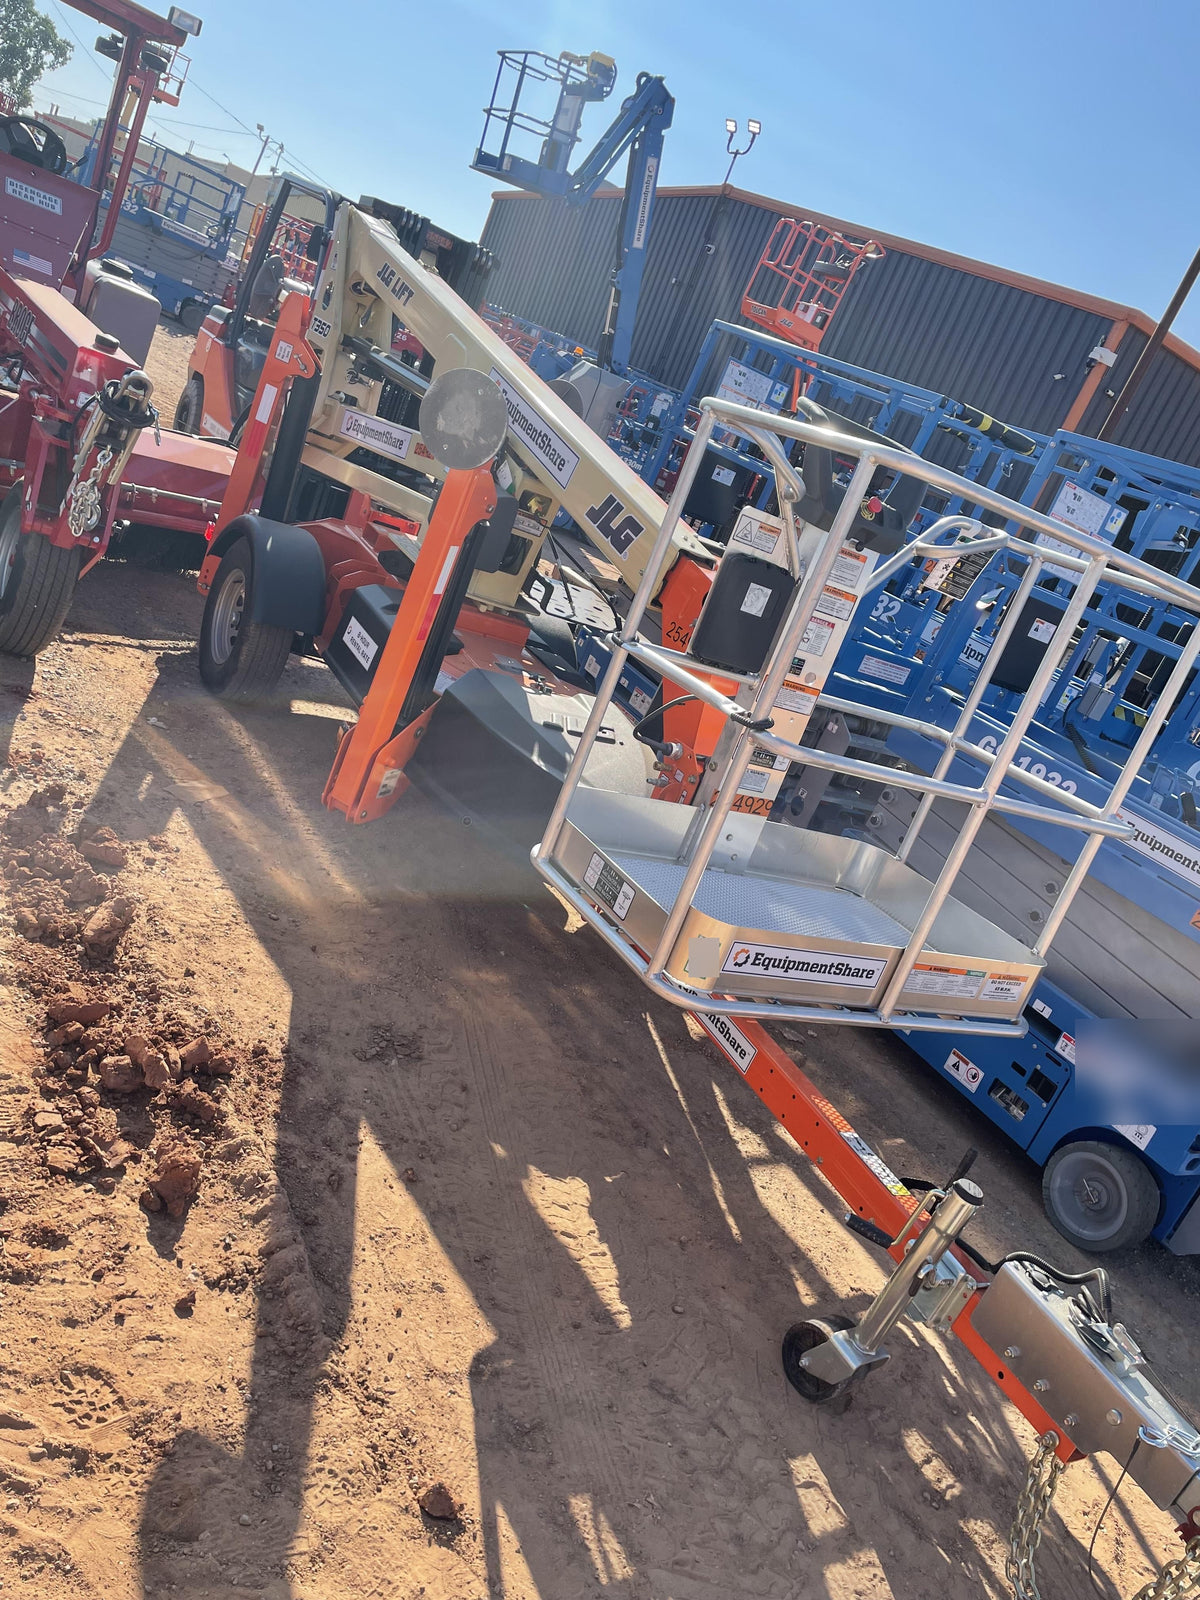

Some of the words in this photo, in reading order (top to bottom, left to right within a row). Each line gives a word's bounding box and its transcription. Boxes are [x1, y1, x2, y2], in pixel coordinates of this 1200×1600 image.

[9, 180, 59, 205] DISENGAGE
[12, 189, 35, 202] REAR
[38, 199, 56, 210] HUB
[636, 174, 653, 242] EquipmentShare
[376, 262, 397, 288] JLG
[390, 277, 415, 307] LIFT
[310, 317, 332, 338] T350
[779, 318, 794, 328] JLG
[352, 419, 404, 450] EquipmentShare
[584, 494, 645, 556] JLG
[665, 621, 692, 648] 254
[785, 682, 806, 692] WARNING
[750, 952, 875, 980] EquipmentShare
